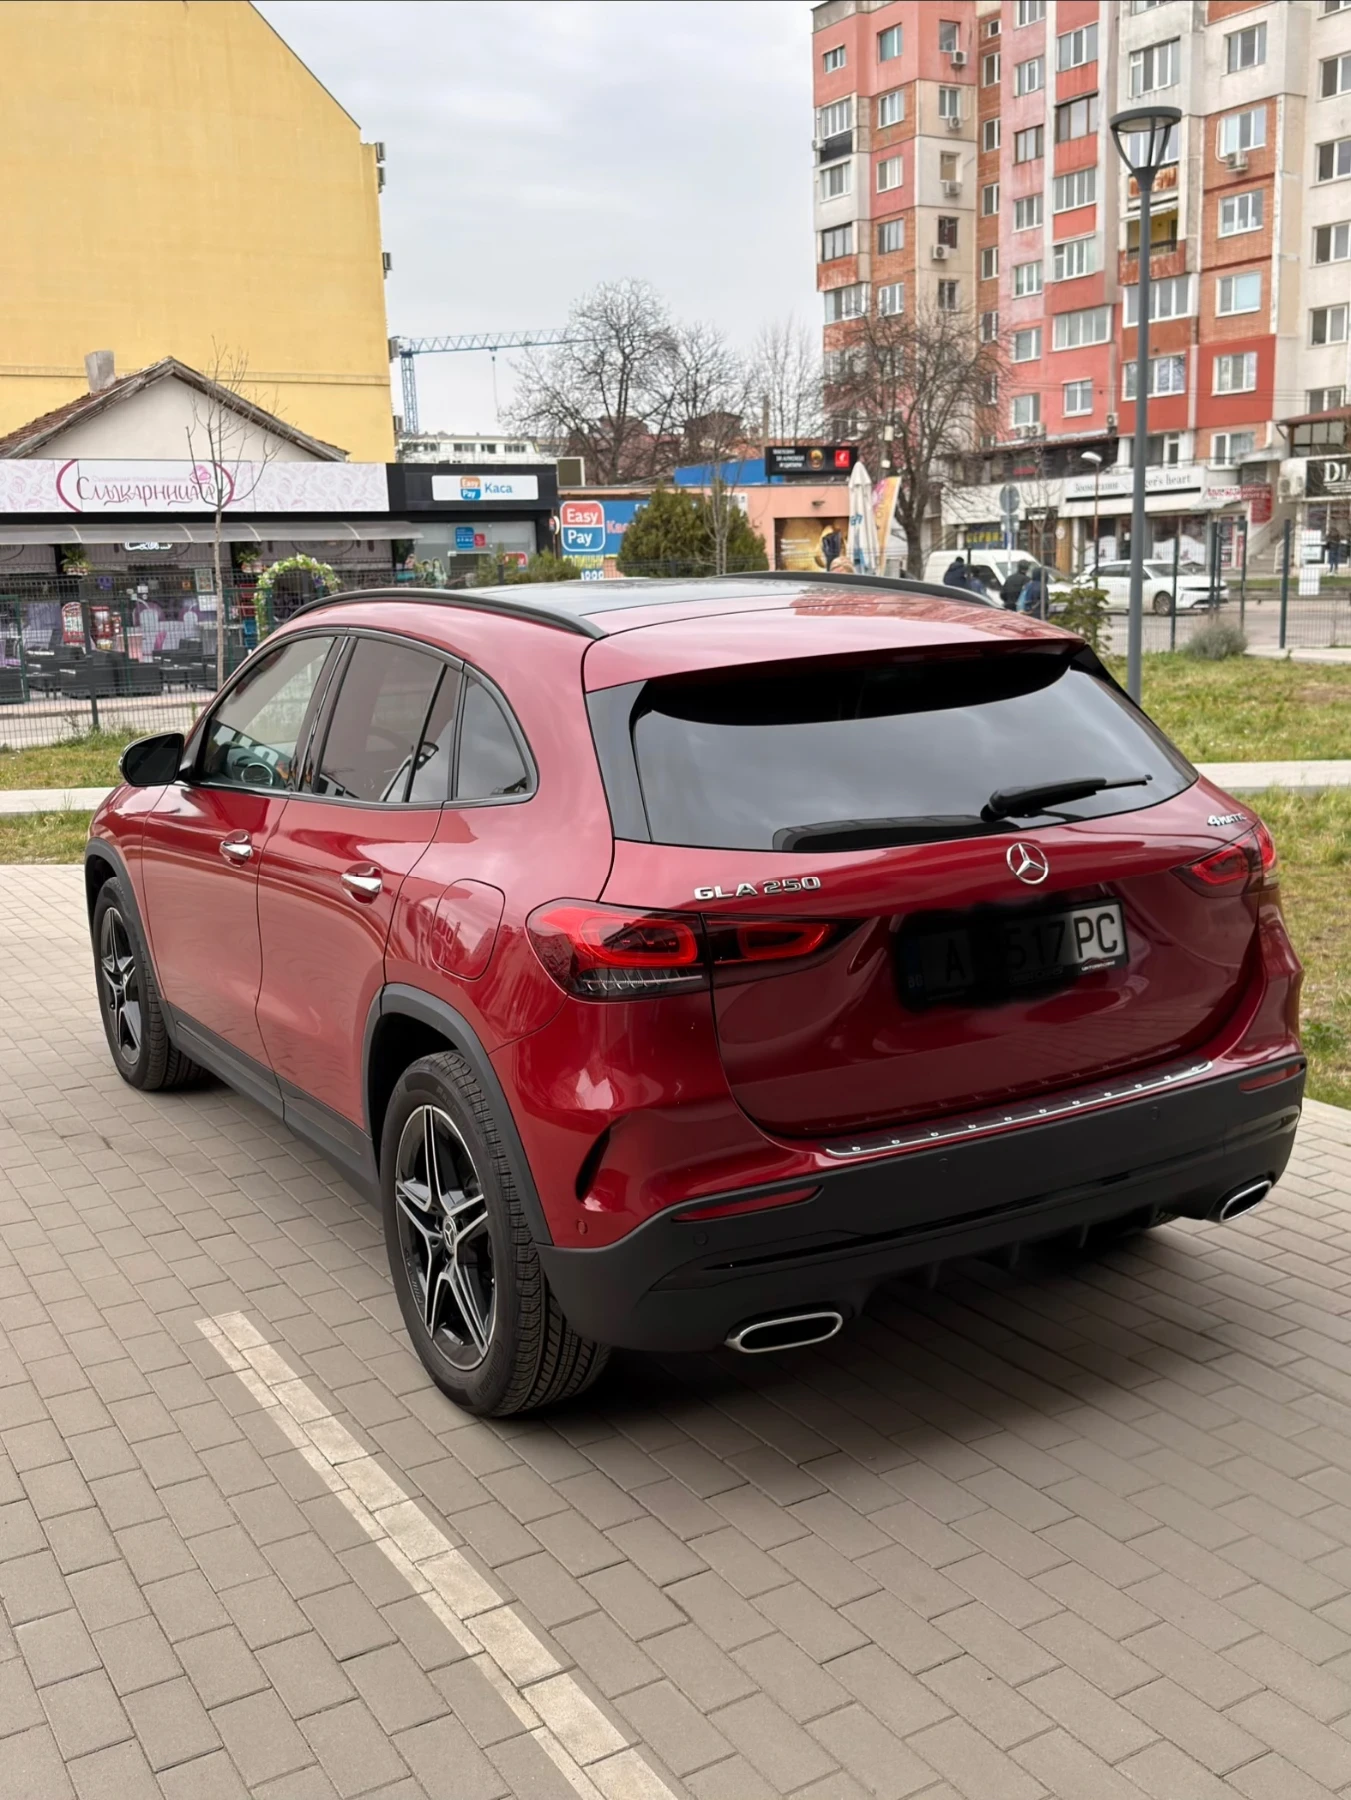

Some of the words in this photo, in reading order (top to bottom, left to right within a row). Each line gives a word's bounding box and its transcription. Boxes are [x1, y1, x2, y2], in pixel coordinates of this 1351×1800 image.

[1324, 461, 1351, 482] DI
[462, 479, 479, 487] Easy
[484, 483, 513, 494] Каса
[462, 489, 477, 499] Pay
[566, 508, 599, 526] Easy
[567, 529, 593, 547] Pay
[693, 882, 758, 901] GLA
[762, 876, 821, 894] 250
[1073, 912, 1118, 959] PC
